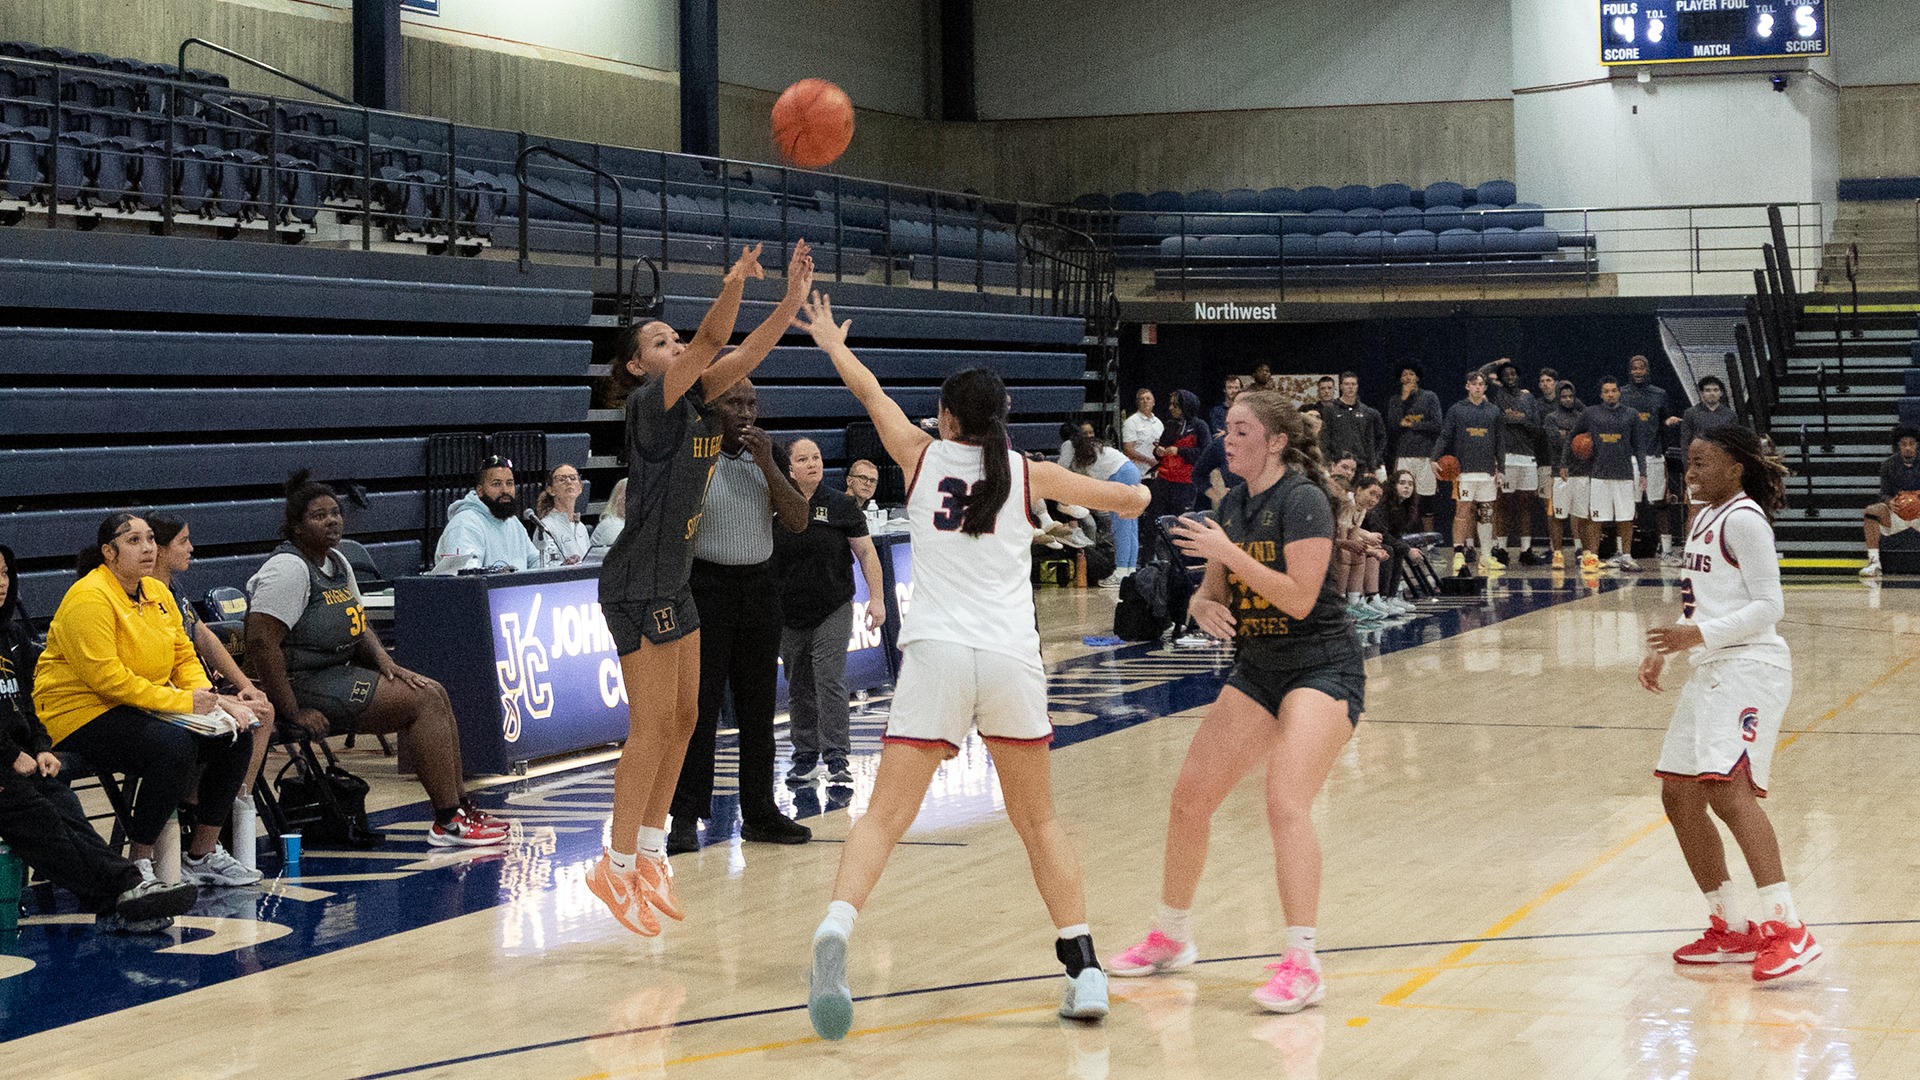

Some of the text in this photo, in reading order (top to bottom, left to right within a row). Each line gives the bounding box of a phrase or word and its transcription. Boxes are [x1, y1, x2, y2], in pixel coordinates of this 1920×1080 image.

[1603, 3, 1638, 15] FOULS
[1676, 0, 1749, 11] PLAYER FOUL
[1796, 5, 1817, 37] 5
[1613, 16, 1635, 43] 4
[1604, 47, 1640, 60] SCORE
[1693, 44, 1731, 56] MATCH
[1785, 40, 1822, 52] SCORE
[1195, 302, 1277, 320] Northwest
[933, 476, 996, 534] 3
[653, 607, 676, 634] H
